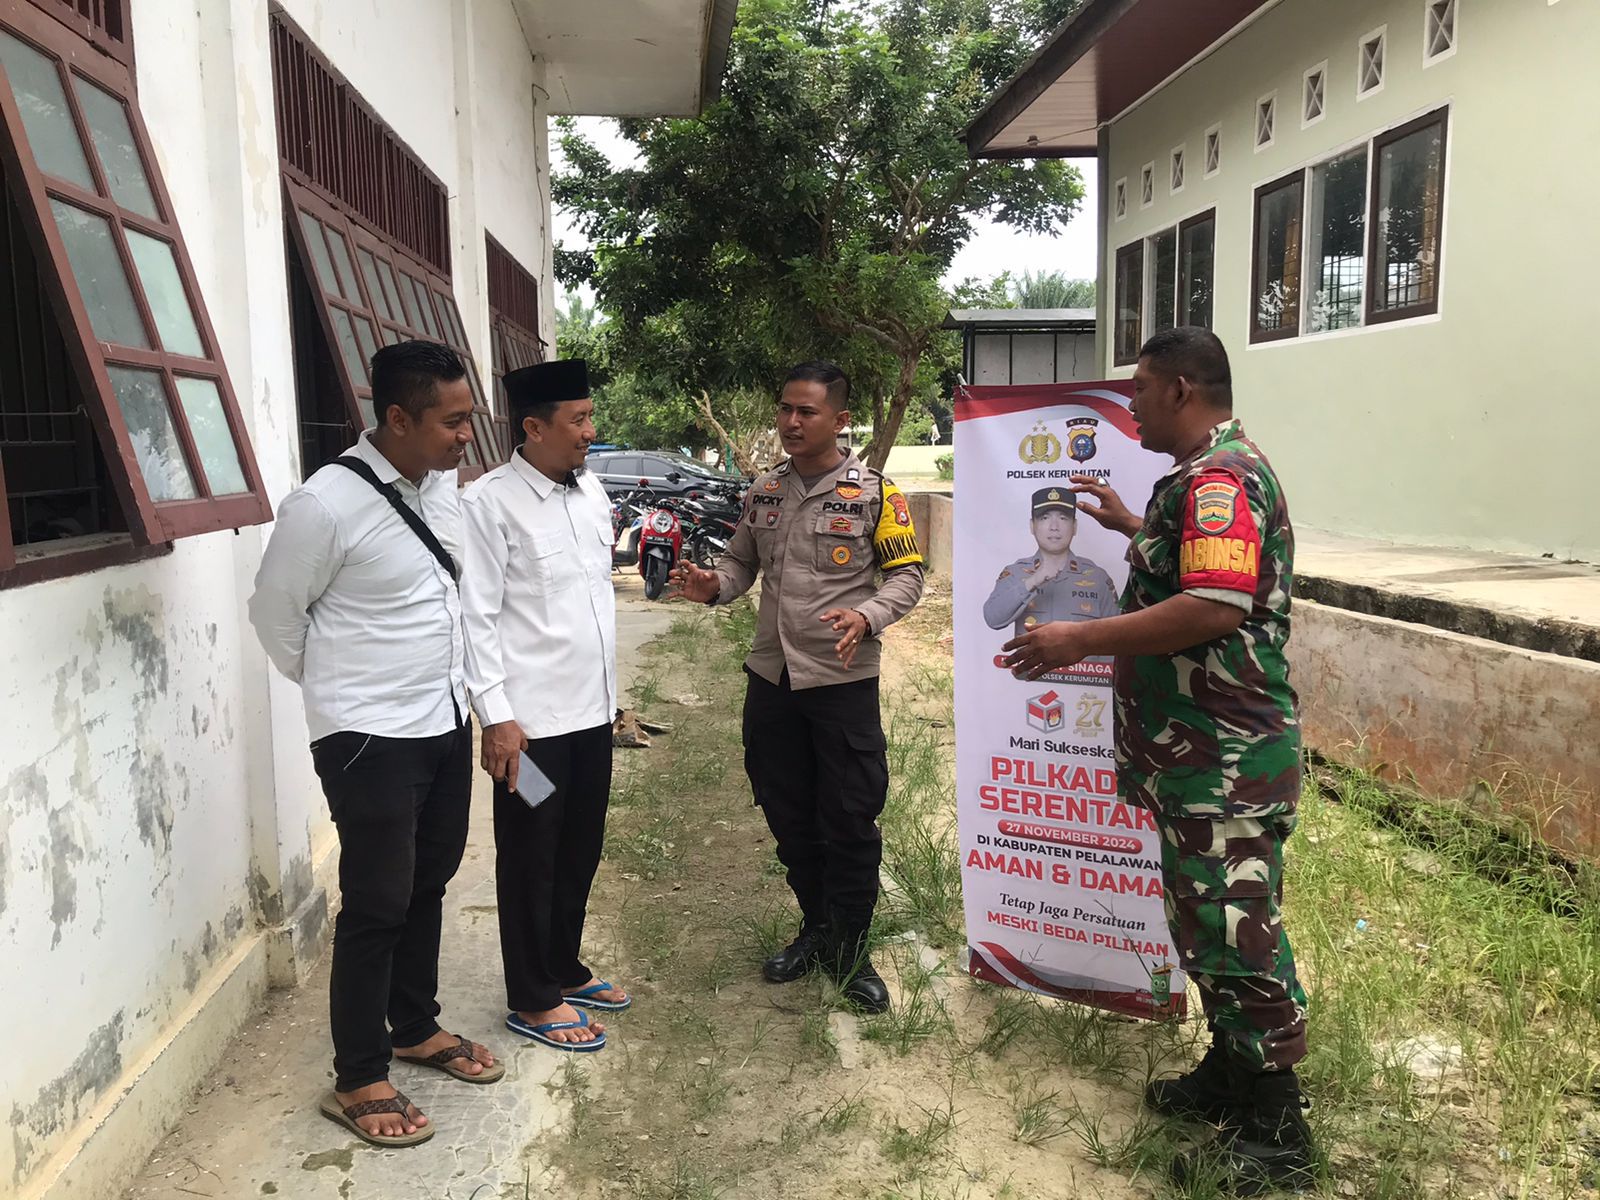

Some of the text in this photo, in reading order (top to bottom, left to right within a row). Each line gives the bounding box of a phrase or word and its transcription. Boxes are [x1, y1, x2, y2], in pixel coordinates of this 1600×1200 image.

[1007, 469, 1111, 479] POLSEK KERUMUTAN
[752, 494, 784, 507] DICKY
[822, 501, 864, 514] POLRI
[1179, 537, 1257, 577] ABINSA
[1071, 590, 1098, 599] POLRI
[1041, 673, 1109, 684] OLSEK KERUMUTAN
[1068, 663, 1113, 675] SINAGA
[1075, 699, 1107, 727] 27
[1009, 736, 1115, 759] Mari Sukseska
[990, 756, 1117, 795] PILKAD
[977, 834, 990, 846] DI
[993, 837, 1072, 859] KABUPATEN
[1006, 822, 1136, 850] 27 NOVEMBER 2024
[966, 848, 1164, 899] AMAN & DAMA
[999, 892, 1146, 932] Tetap Jaga Persatuan
[987, 910, 1169, 957] MESKI BEDA PILIHAN
